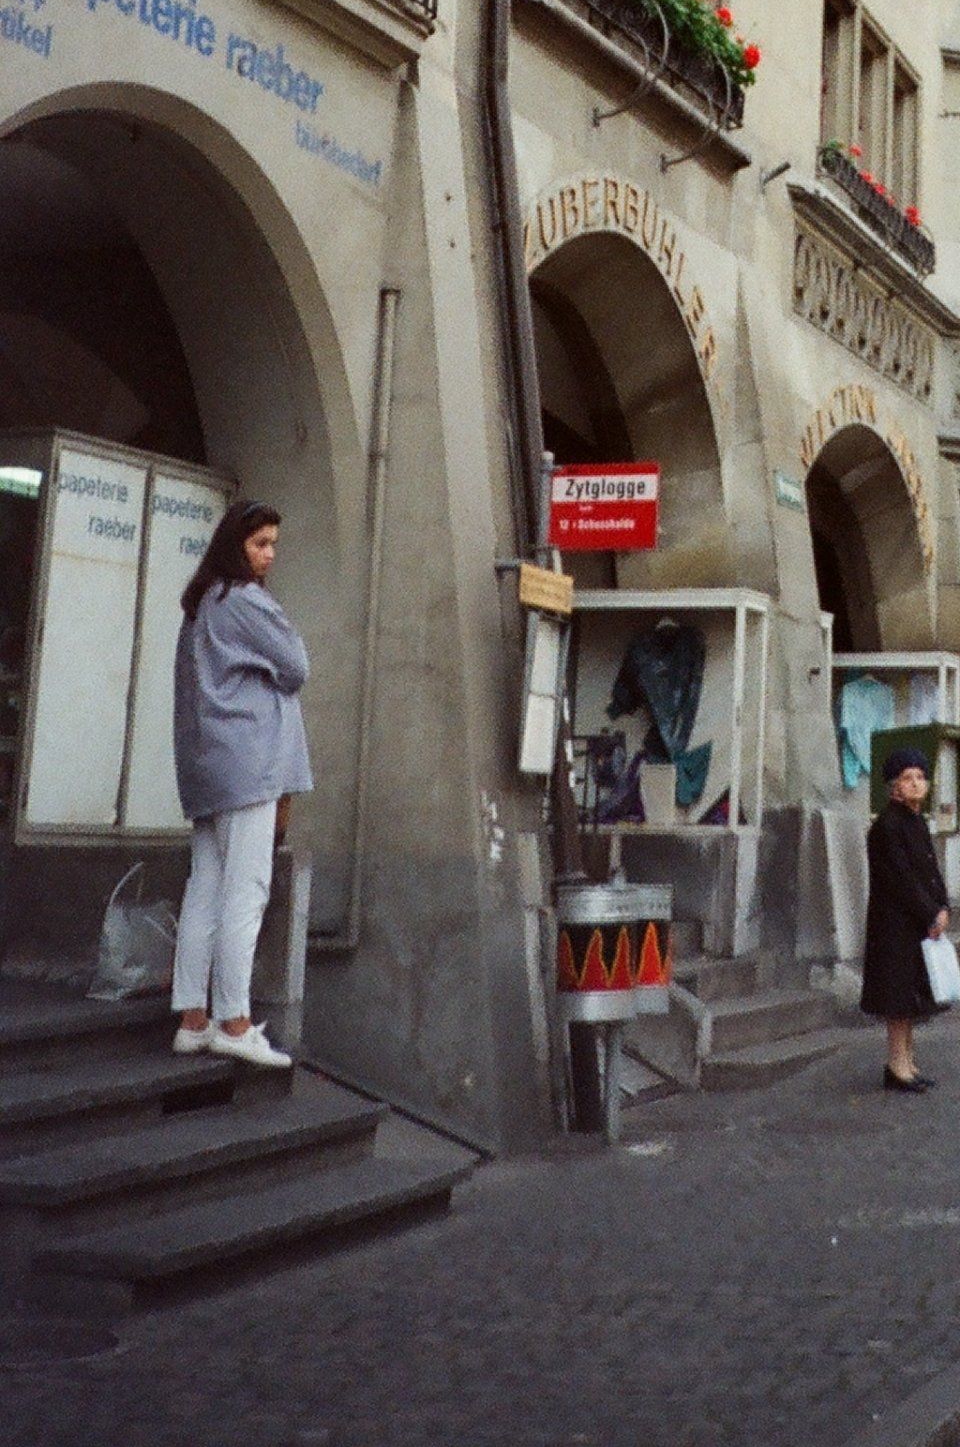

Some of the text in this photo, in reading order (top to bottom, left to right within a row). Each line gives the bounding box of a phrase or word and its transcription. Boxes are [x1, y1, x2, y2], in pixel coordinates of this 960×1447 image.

[226, 34, 325, 114] raeber
[58, 472, 130, 503] papeterie
[565, 478, 647, 500] Zytglogge
[87, 513, 137, 542] raeber
